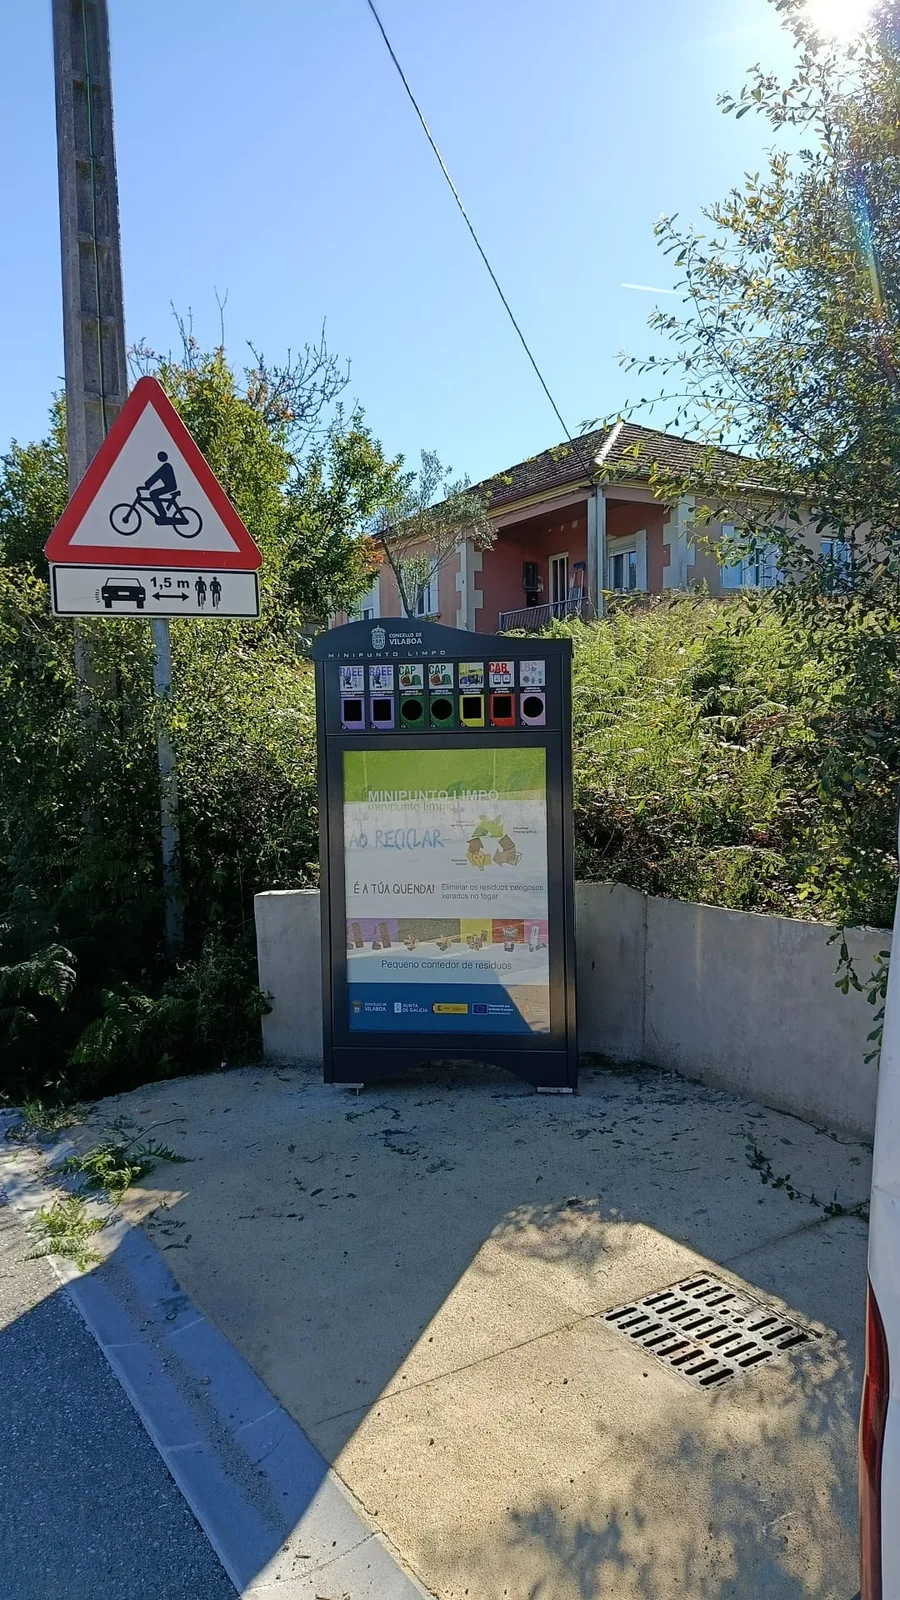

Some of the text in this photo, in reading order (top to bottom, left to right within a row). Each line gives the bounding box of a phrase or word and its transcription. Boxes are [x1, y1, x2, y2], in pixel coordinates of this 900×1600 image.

[150, 576, 190, 590] 1,5 m
[399, 665, 416, 675] CAP
[428, 664, 446, 674] CAP
[368, 790, 499, 802] MINIPUNTO LIMPO
[368, 801, 455, 812] minipunto limpio
[353, 882, 360, 894] É
[363, 884, 369, 894] A
[371, 882, 390, 894] TÚA
[382, 960, 512, 971] Pequeno contedor de residuos
